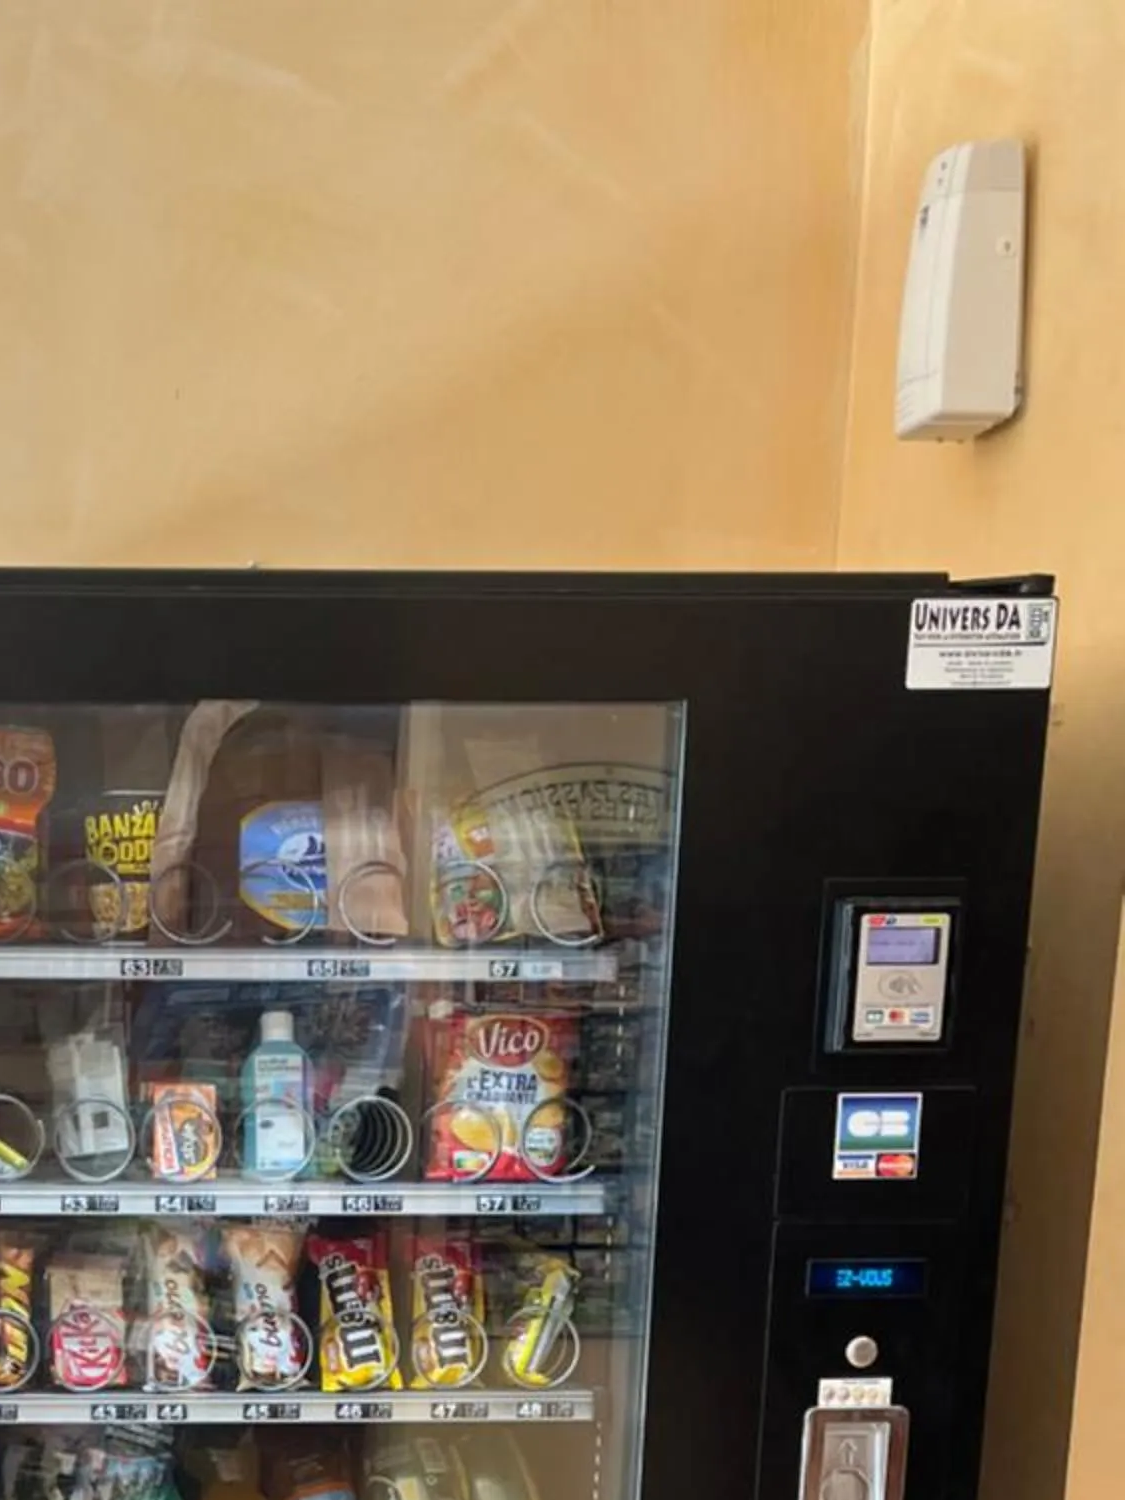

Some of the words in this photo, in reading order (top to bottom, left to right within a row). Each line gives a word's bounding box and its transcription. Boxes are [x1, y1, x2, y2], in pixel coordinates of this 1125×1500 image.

[996, 602, 1022, 631] DA
[491, 960, 517, 976] 67
[478, 1021, 541, 1058] Vico
[478, 1196, 505, 1212] 57
[159, 1405, 183, 1420] 44
[245, 1403, 269, 1419] 45
[433, 1402, 457, 1418] 47
